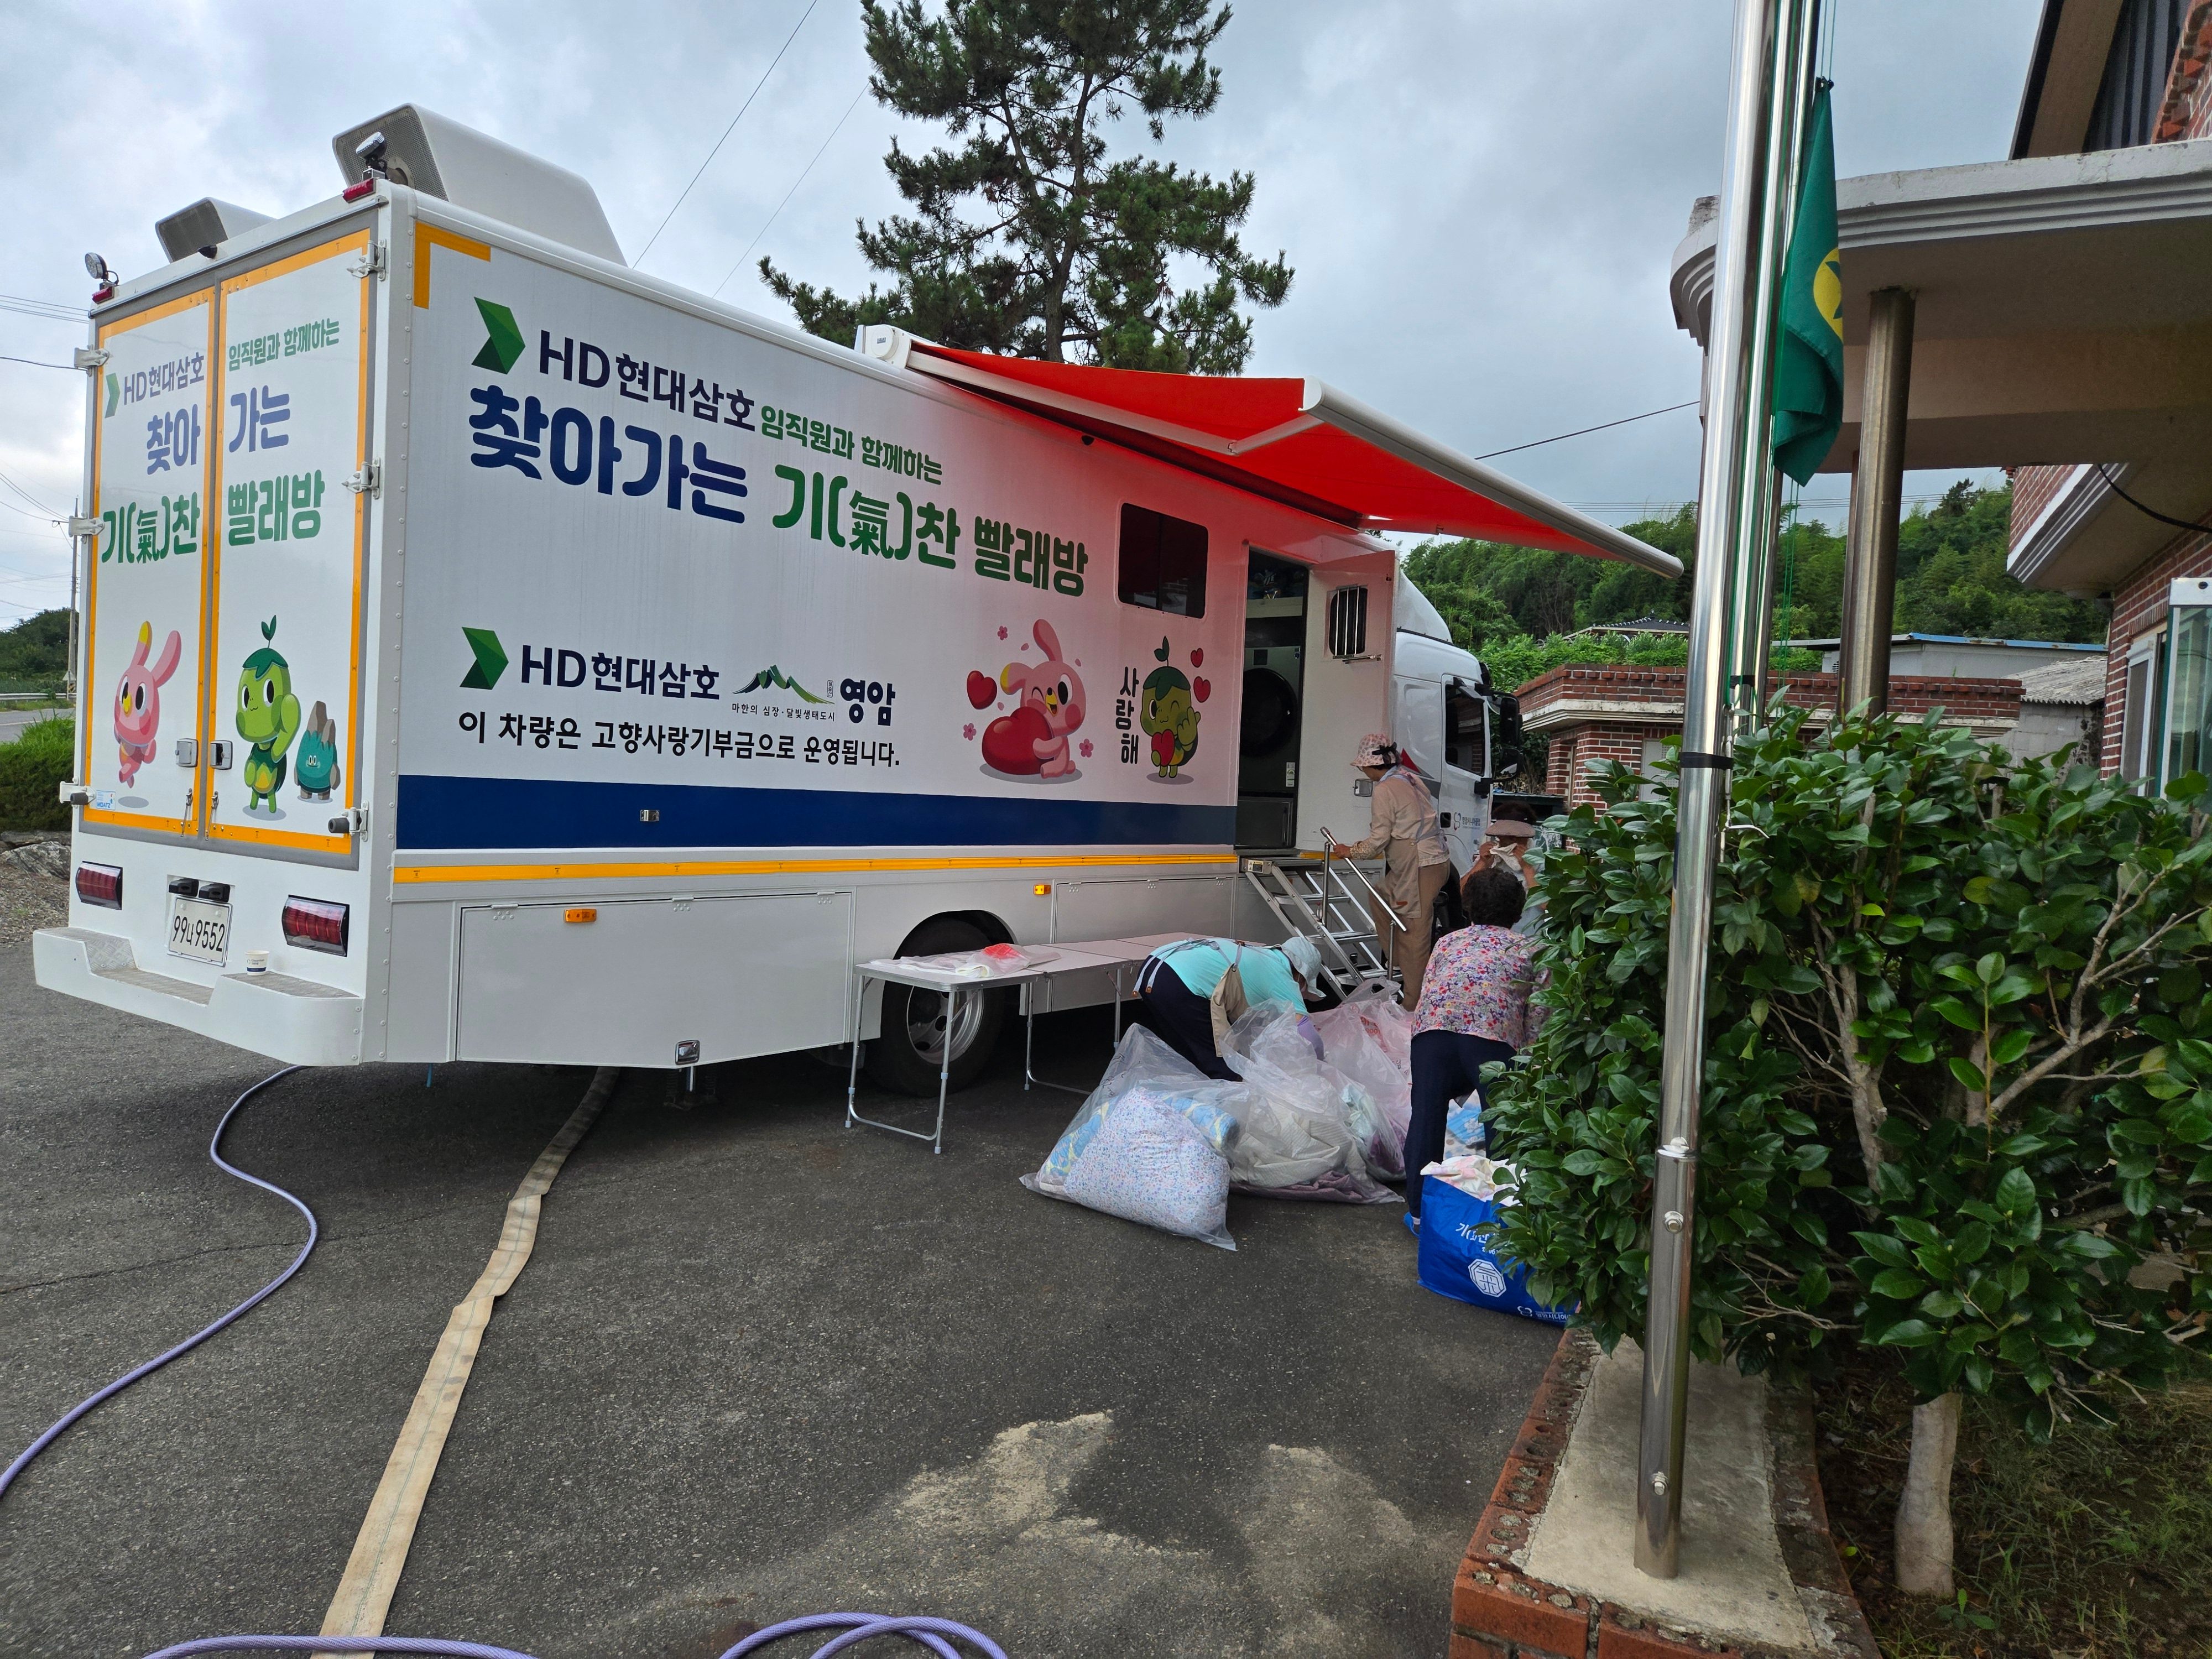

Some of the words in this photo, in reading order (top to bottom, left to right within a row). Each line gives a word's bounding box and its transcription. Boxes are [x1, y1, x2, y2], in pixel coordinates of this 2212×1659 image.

[124, 352, 205, 405] HD현대삼호
[228, 332, 280, 371] 임직원과
[284, 318, 340, 357] 함께하는
[539, 330, 755, 431] HD현대삼호
[761, 405, 854, 460] 임직원과
[861, 436, 942, 485] 함께하는
[228, 469, 325, 546] 빨래방
[469, 385, 748, 524] 찾아가는
[974, 516, 1089, 597] 빨래방
[521, 644, 719, 700] HD현대삼호
[732, 703, 758, 714] 마한의
[840, 679, 896, 726] 영암
[458, 711, 486, 744] 이
[498, 713, 581, 749] 차량은
[592, 721, 795, 759] 고향사랑기부금으로
[804, 736, 900, 767] 운영됩니다.
[173, 915, 225, 952] 99나9552
